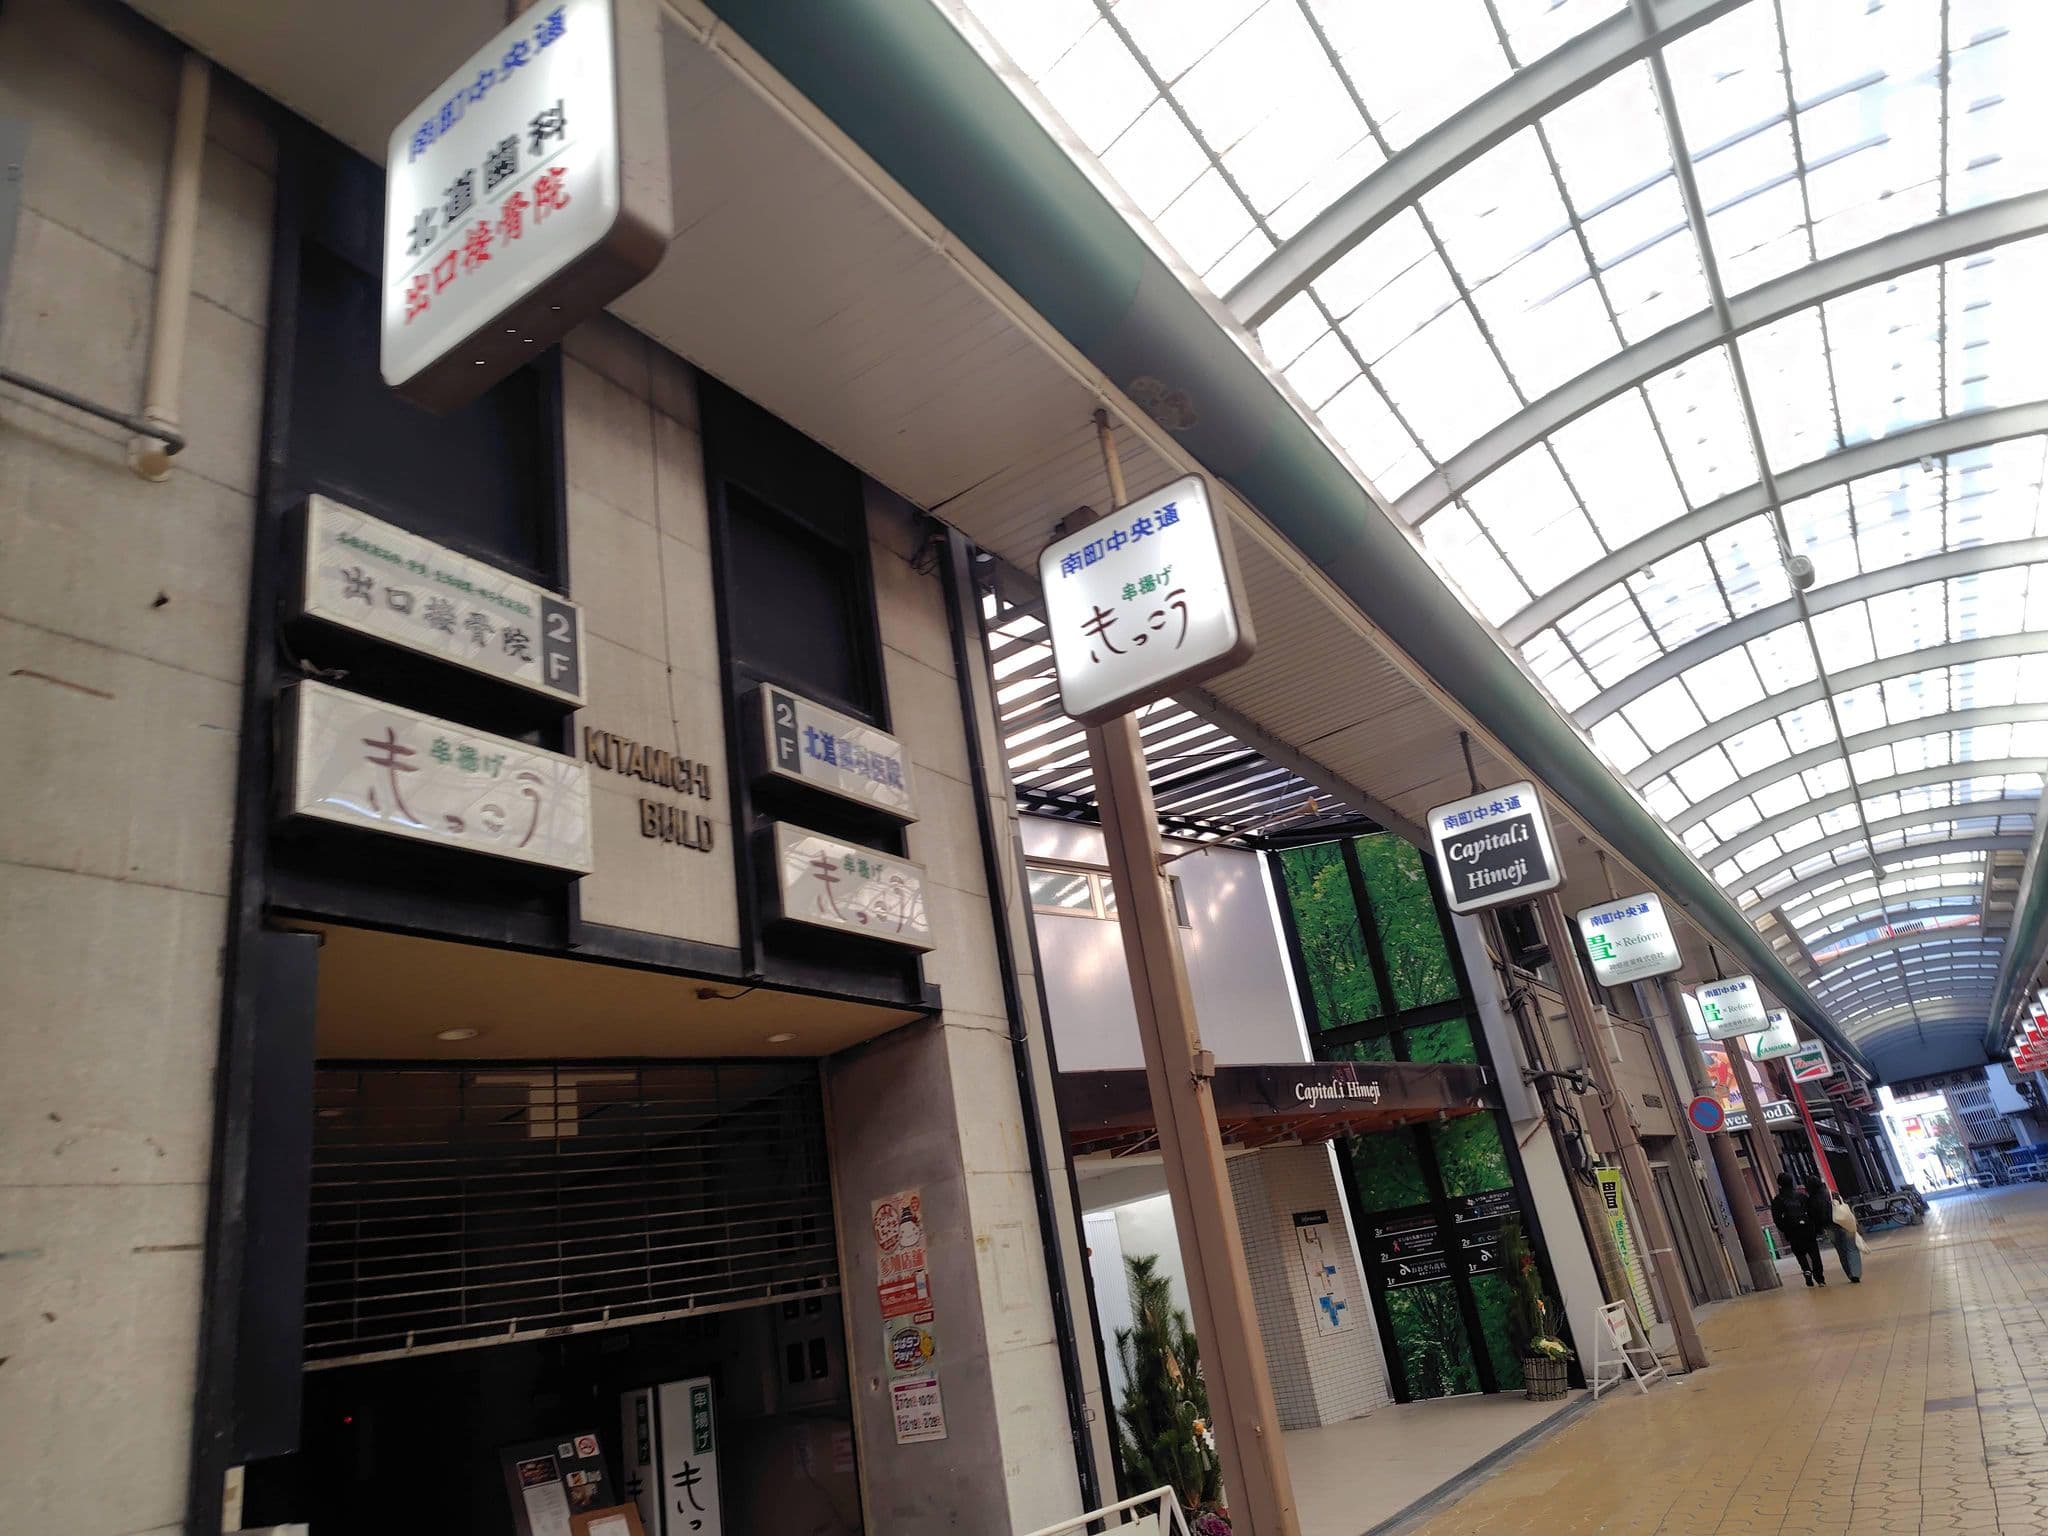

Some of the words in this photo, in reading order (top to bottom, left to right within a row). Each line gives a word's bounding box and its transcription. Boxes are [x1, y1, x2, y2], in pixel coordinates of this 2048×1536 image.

[409, 4, 567, 163] 南町中央通
[405, 167, 571, 325] 出口接骨院
[1060, 502, 1180, 578] 南町中央通
[1122, 564, 1173, 602] 串揚げ
[341, 566, 534, 663] 出口接骨院
[1080, 588, 1188, 664] きっこう
[431, 735, 506, 778] 串揚げ
[363, 727, 543, 848] きっこう
[639, 799, 714, 853] BUILD
[1443, 795, 1522, 831] 南町中央通
[842, 854, 883, 880] 串揚げ
[1449, 823, 1530, 865] Capital.i
[810, 850, 905, 933] きっこう
[1467, 858, 1529, 890] Himeji
[1590, 902, 1650, 928] 南町中央通
[1704, 982, 1748, 999] 南町中央通
[1347, 1081, 1381, 1104] Himeji
[693, 1388, 709, 1450] 串揚げ
